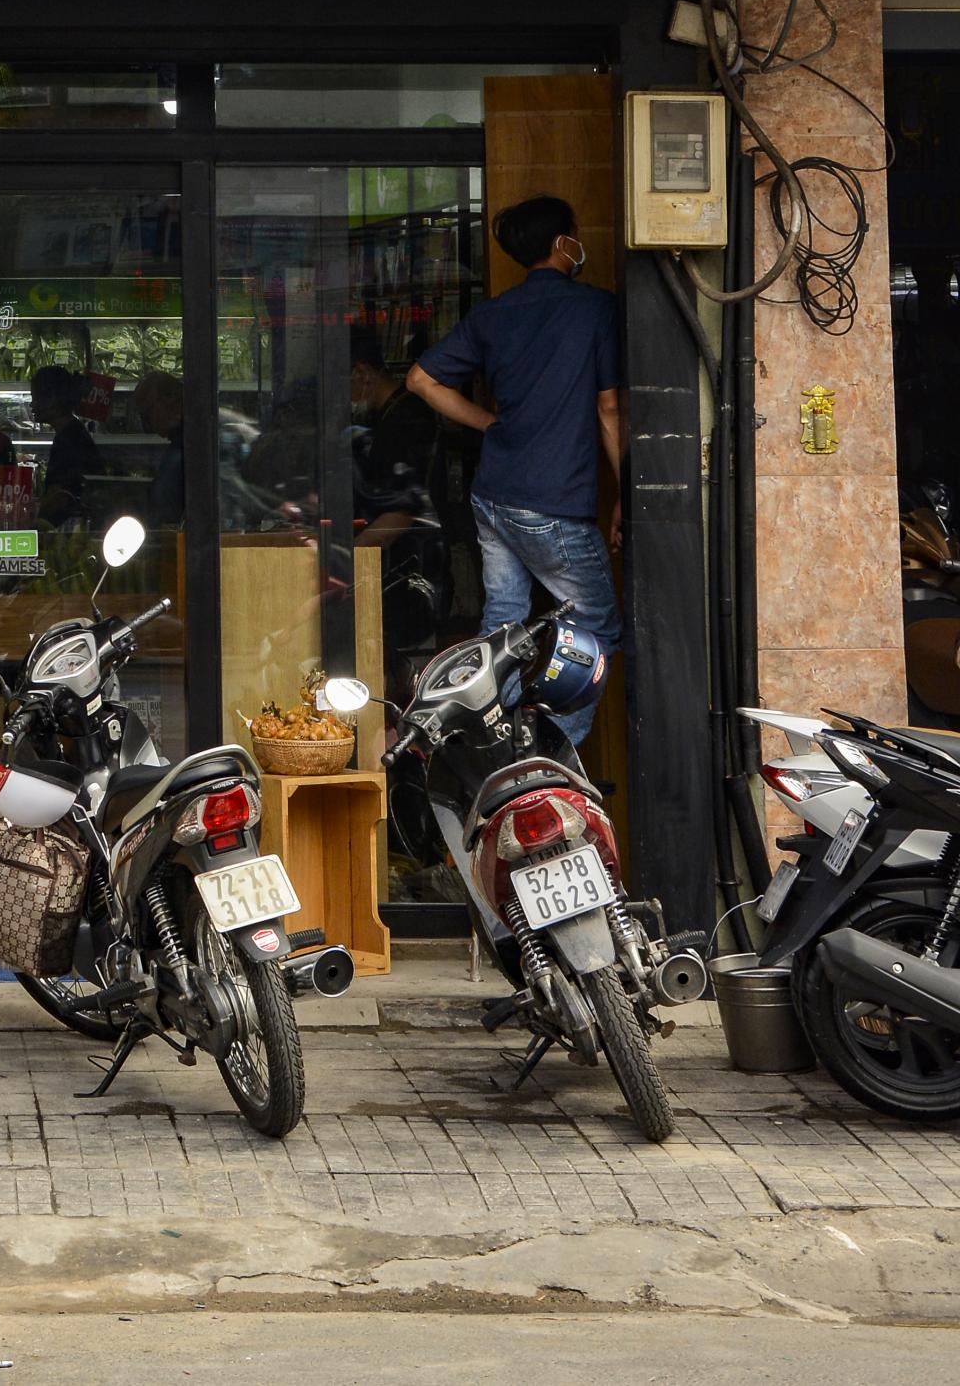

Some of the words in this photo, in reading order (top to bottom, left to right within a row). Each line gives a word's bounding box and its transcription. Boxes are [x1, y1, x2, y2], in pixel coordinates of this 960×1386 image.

[212, 781, 235, 790] HONDA
[209, 863, 273, 900] 72-X1
[526, 855, 589, 894] 52-P8
[221, 888, 284, 924] 3148
[536, 880, 599, 919] 0629
